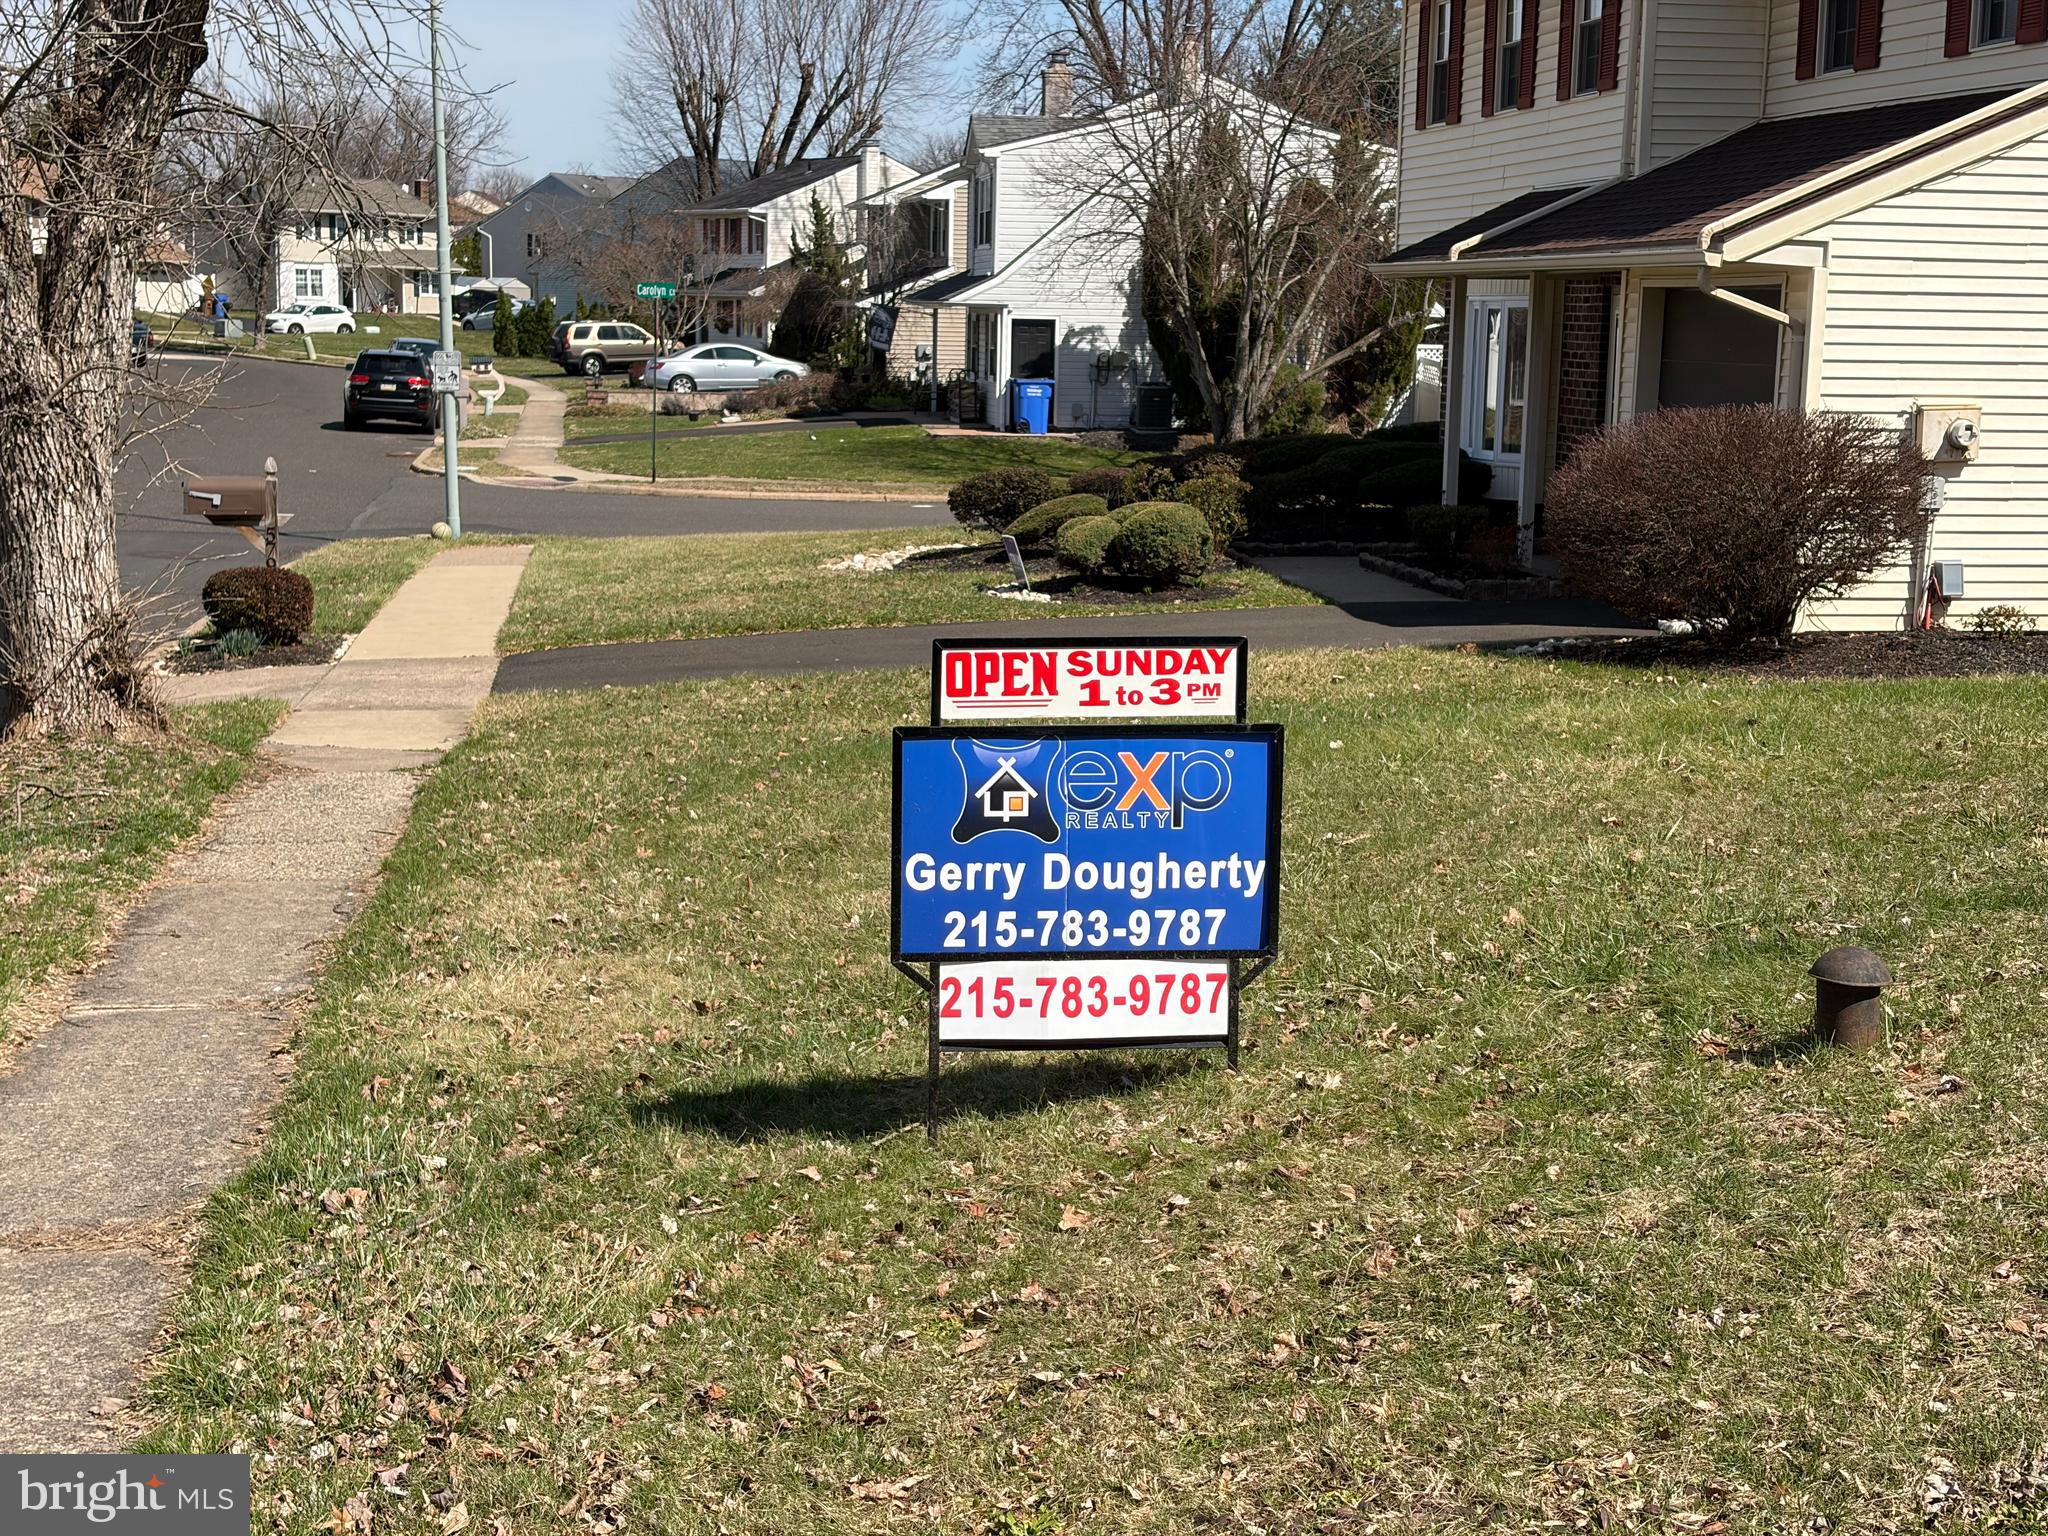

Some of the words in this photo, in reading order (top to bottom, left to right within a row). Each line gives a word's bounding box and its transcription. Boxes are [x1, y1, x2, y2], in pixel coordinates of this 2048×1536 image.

[636, 284, 667, 298] Carolyn
[945, 651, 1059, 698] OPEN
[1066, 649, 1233, 677] SUNDAY
[1079, 680, 1110, 707] 1
[1116, 686, 1144, 706] to
[1149, 678, 1182, 706] 3
[1187, 683, 1222, 697] PM
[1065, 812, 1170, 829] REALTY
[905, 852, 1026, 900] Gerry
[1043, 852, 1266, 899] Dougherty
[943, 908, 1227, 948] 215-783-9787
[939, 973, 1228, 1019] 215-783-9787
